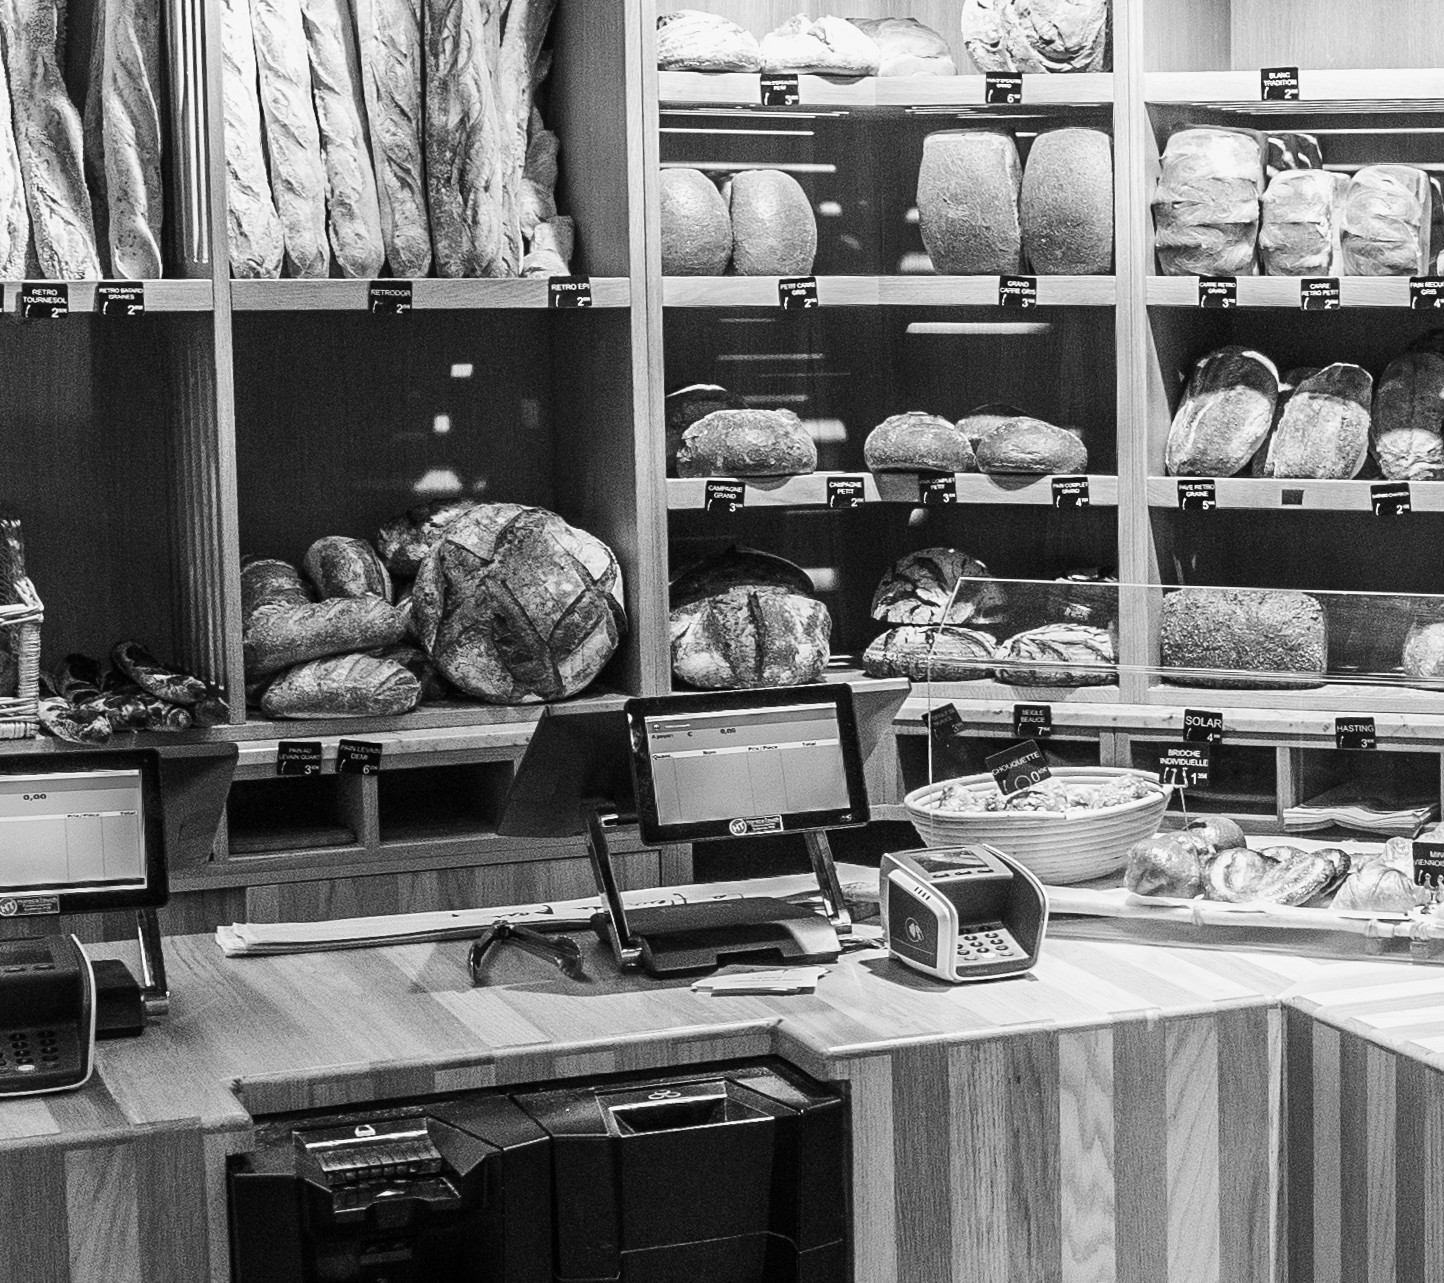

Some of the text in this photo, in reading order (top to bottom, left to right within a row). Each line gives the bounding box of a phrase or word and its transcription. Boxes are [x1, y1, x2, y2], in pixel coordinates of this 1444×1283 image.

[550, 283, 577, 291] RETRO
[22, 296, 68, 305] TOURNESOL
[1184, 715, 1222, 729] SOLAR
[1336, 724, 1375, 733] HASTING
[1167, 748, 1201, 758] BRIOCHE
[1159, 757, 1209, 767] INDIVIDUELLE
